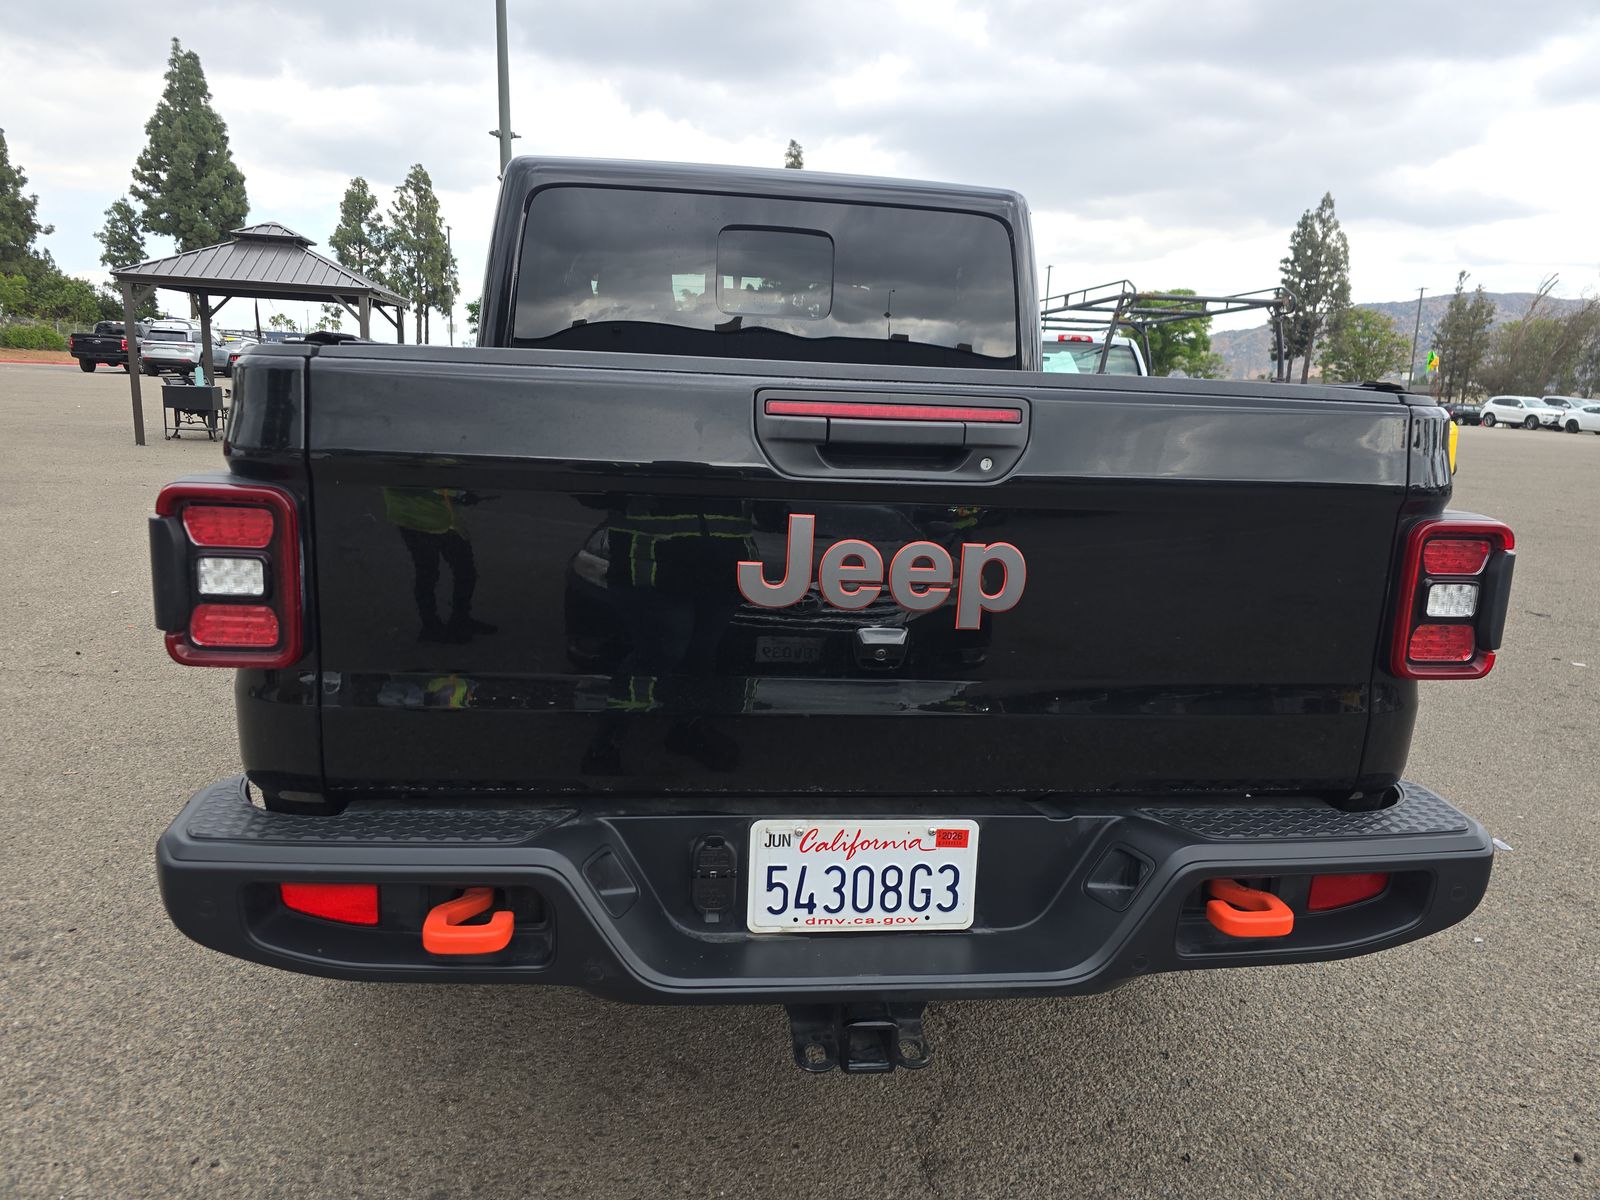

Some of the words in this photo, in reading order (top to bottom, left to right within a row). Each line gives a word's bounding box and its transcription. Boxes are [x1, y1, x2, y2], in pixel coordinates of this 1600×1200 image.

[737, 513, 1027, 630] Jeep
[764, 833, 792, 848] JUN
[799, 828, 937, 860] California
[942, 831, 964, 841] 2026
[766, 863, 961, 916] 54308G3
[805, 917, 919, 926] dmv.ca.gov
